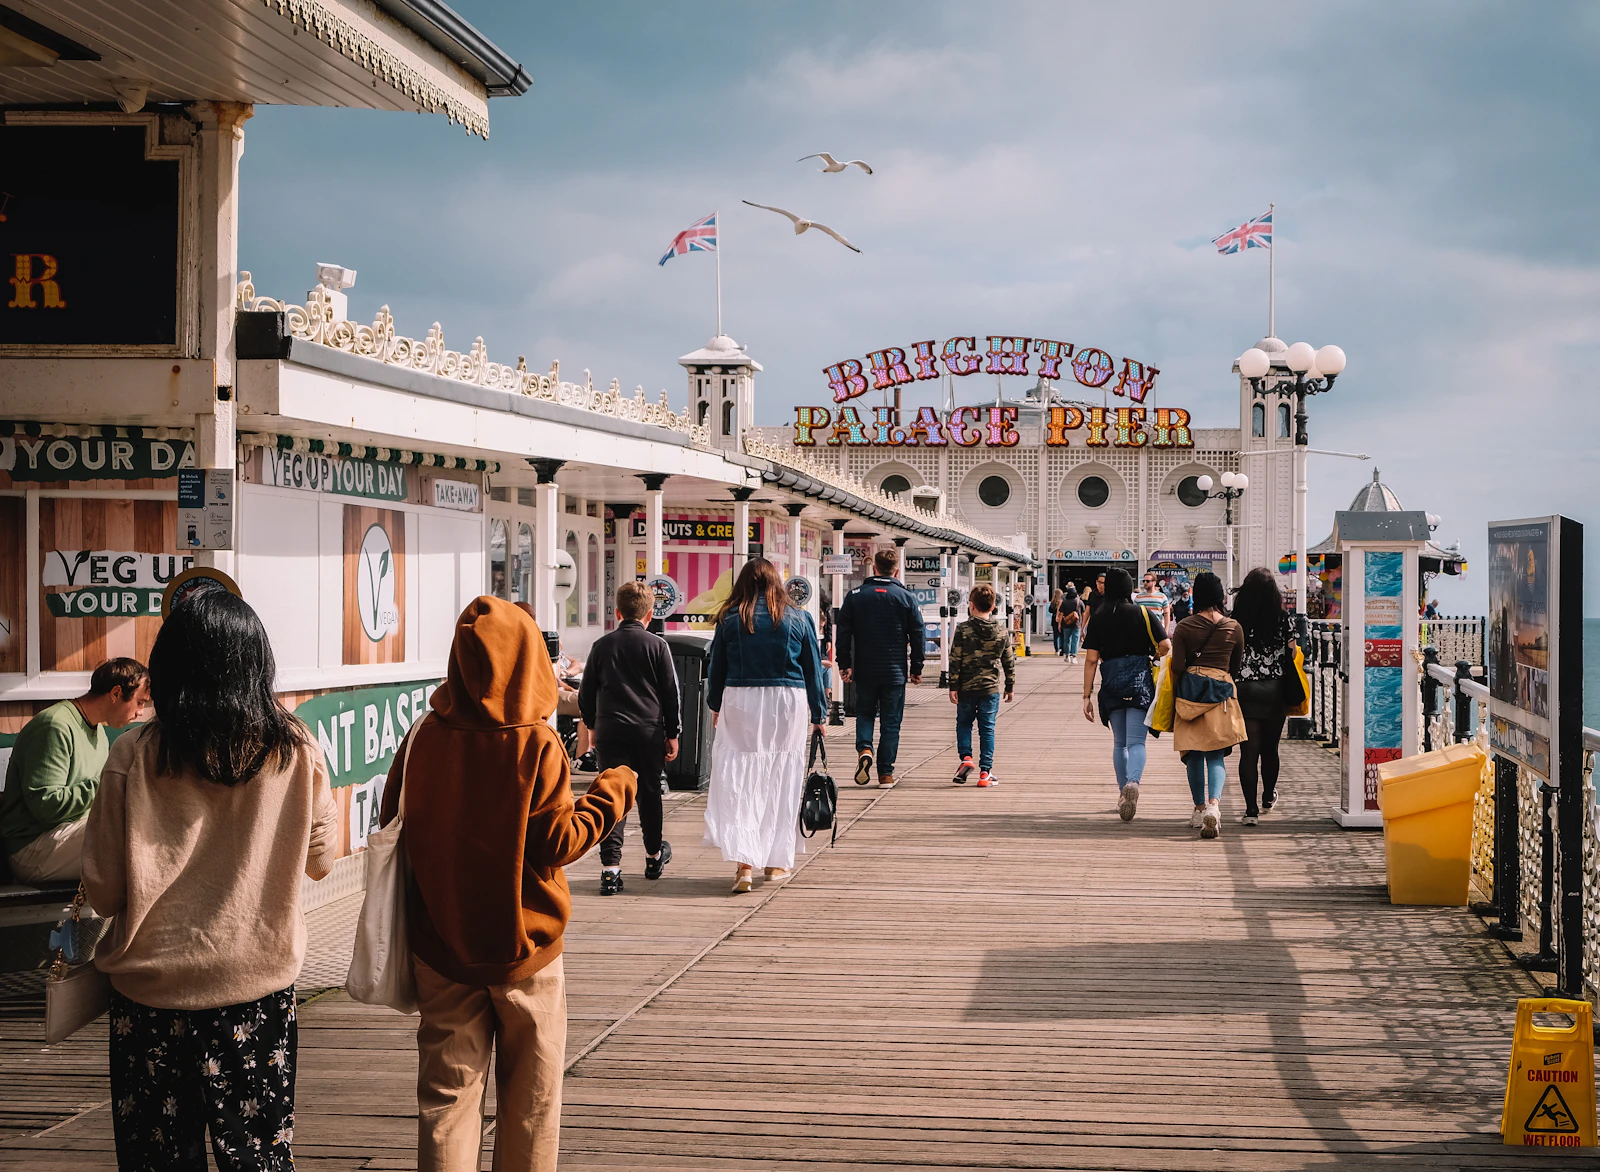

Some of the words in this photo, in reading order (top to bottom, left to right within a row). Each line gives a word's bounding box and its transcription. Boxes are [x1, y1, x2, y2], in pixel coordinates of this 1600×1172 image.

[823, 335, 1160, 404] BRIGHTON
[794, 406, 1019, 447] PALACE
[1046, 407, 1194, 448] PIER
[19, 439, 134, 470] YOUR
[333, 459, 374, 494] YOUR
[379, 465, 403, 497] DAY
[638, 521, 692, 536] DNUTS
[696, 523, 705, 537] &
[707, 525, 754, 538] CRES
[59, 592, 138, 613] YOUR
[1527, 1069, 1578, 1083] CAUTION
[1523, 1134, 1546, 1147] WET
[1548, 1134, 1581, 1148] FLOOR
